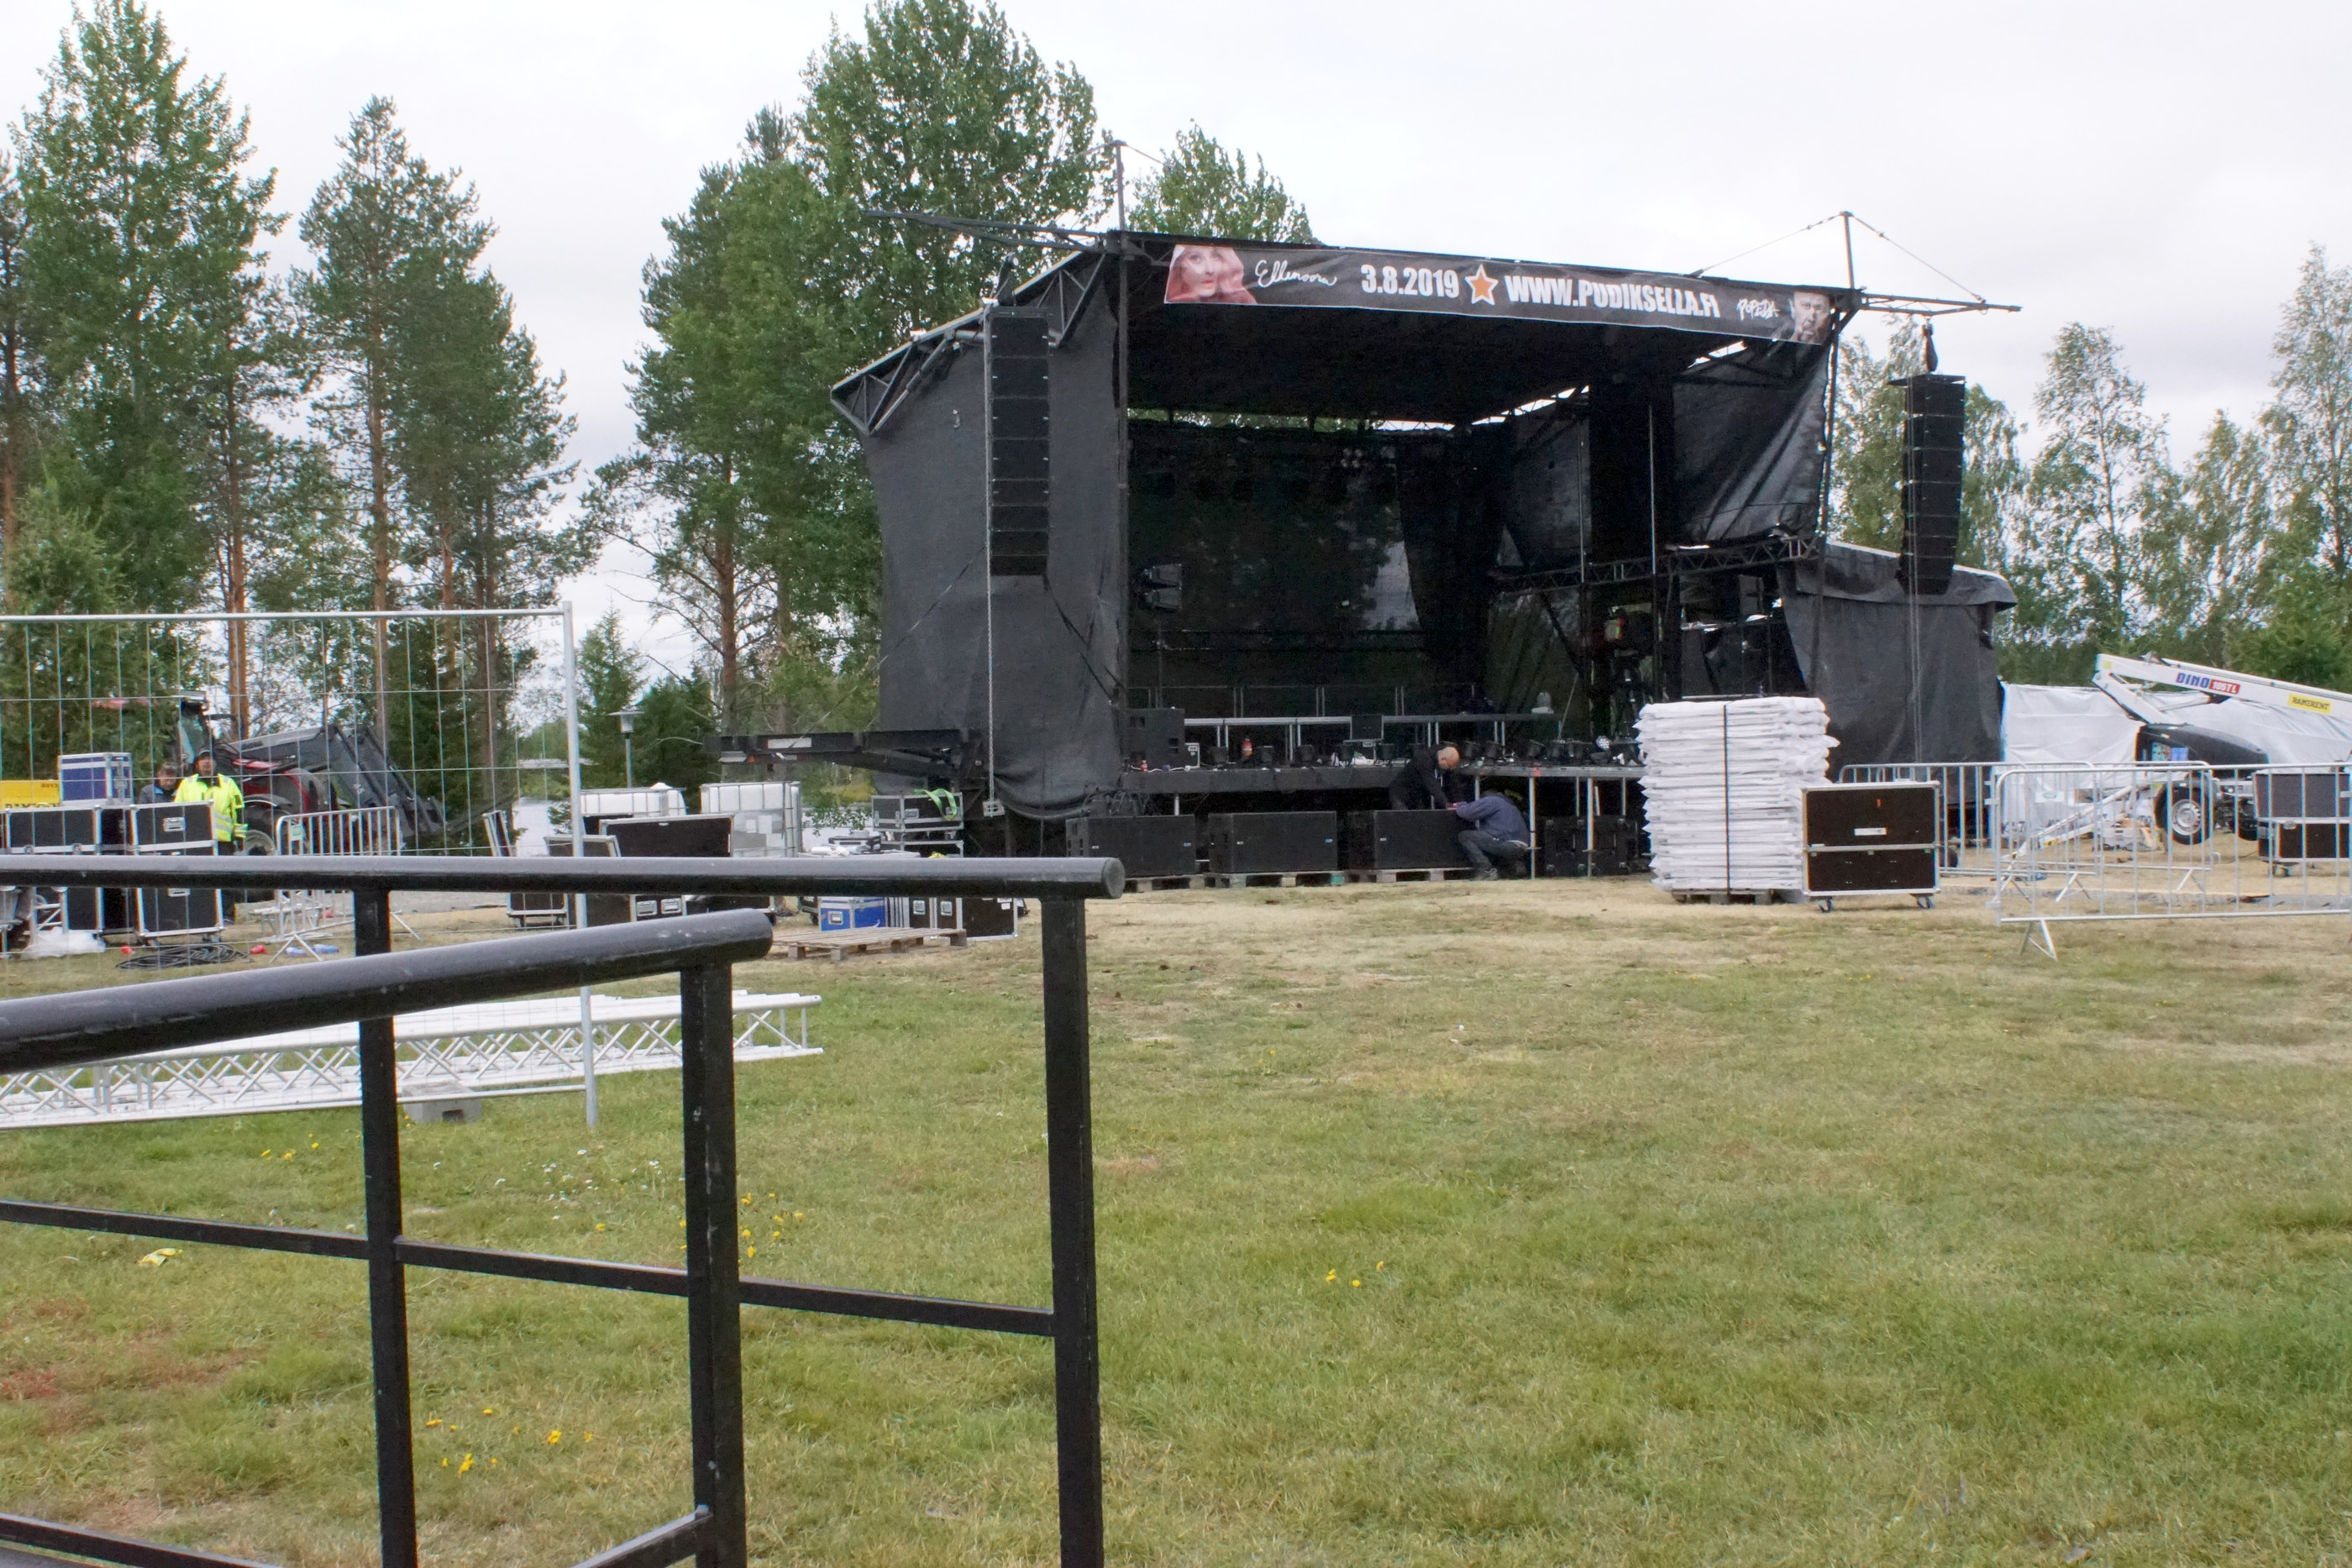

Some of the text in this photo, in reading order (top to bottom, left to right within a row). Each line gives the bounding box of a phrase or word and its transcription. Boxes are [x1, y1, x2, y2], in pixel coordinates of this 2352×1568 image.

[1361, 263, 1459, 299] 3.8.2019
[1504, 275, 1721, 318] WWW.PUDIKSELLA.FI
[2176, 672, 2210, 689] DINO
